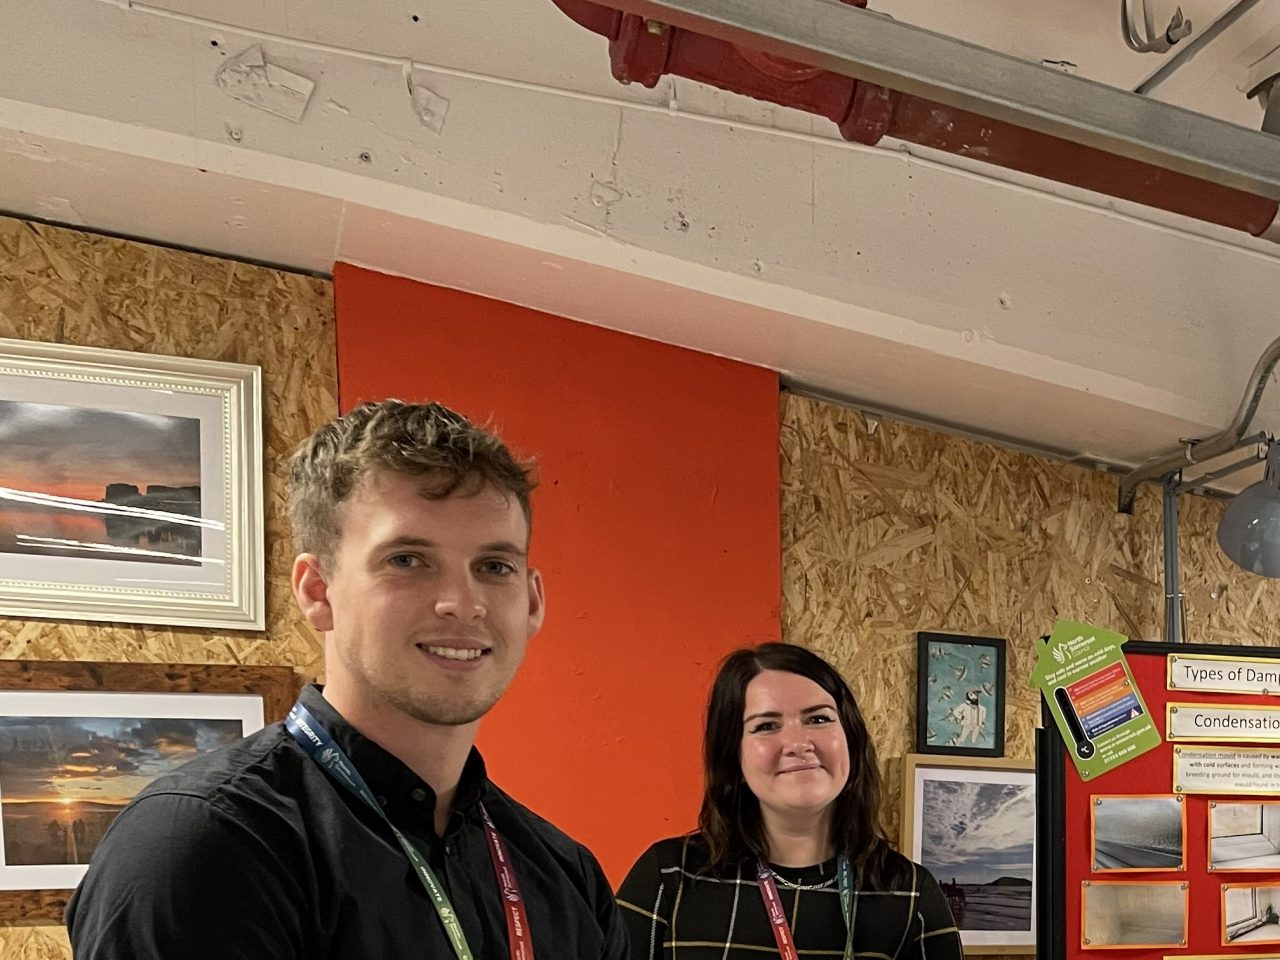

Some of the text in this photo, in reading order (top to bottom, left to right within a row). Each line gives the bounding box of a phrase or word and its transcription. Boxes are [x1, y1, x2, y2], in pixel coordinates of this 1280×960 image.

[1183, 663, 1223, 685] Types
[1227, 666, 1242, 682] of
[1217, 752, 1237, 760] mould
[1242, 752, 1262, 760] caused
[1263, 753, 1271, 761] by
[1216, 761, 1240, 769] surfaces
[1252, 762, 1274, 770] forming
[1185, 771, 1210, 779] breeding
[1211, 771, 1231, 780] ground
[514, 906, 523, 937] RESPECT
